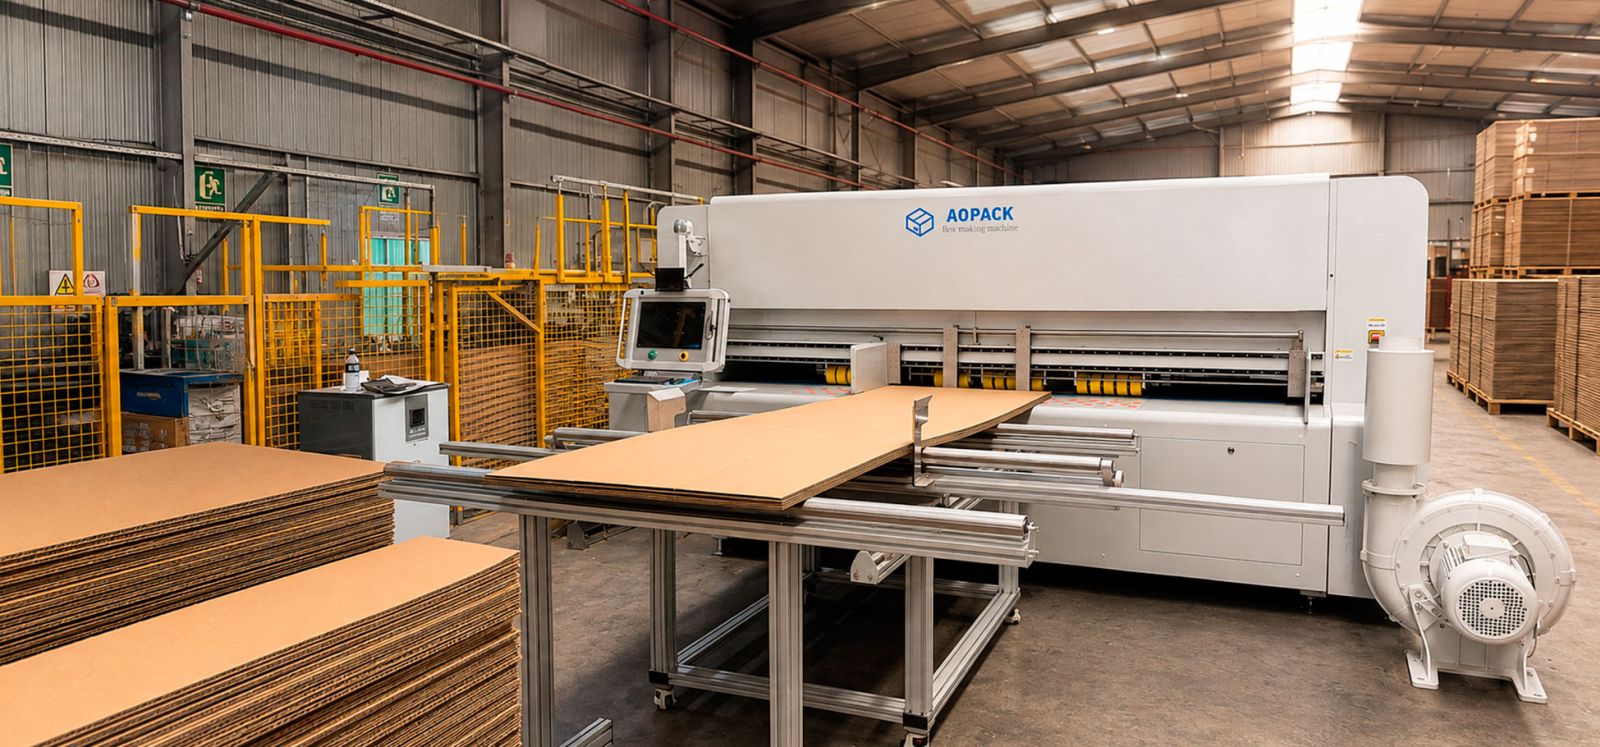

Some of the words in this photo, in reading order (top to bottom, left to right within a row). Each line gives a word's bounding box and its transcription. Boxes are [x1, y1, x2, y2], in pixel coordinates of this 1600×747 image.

[946, 206, 1014, 222] AOPACK
[942, 225, 956, 233] Box
[958, 225, 986, 234] making
[987, 223, 1019, 232] machine
